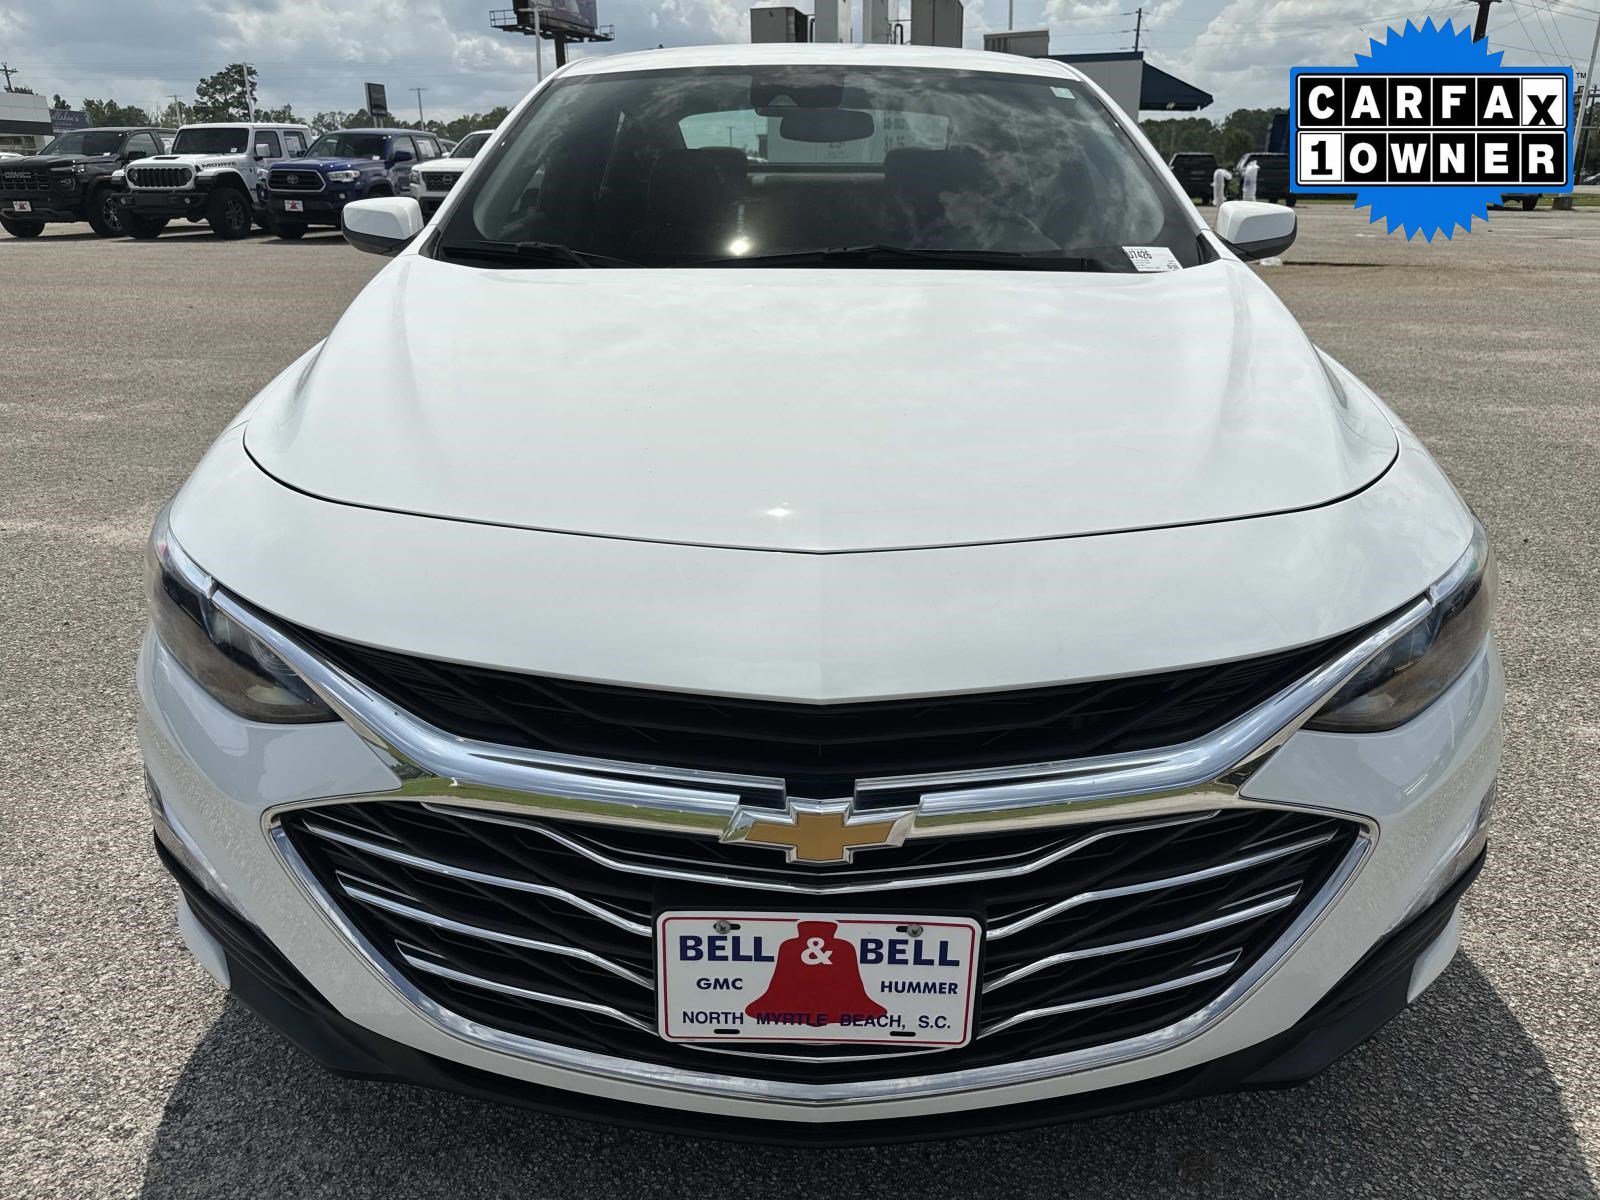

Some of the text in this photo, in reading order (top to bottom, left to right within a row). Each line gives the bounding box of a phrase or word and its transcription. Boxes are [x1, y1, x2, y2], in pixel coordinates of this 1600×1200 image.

[679, 935, 960, 967] BELL & BELL
[696, 977, 743, 991] GMC
[880, 980, 958, 995] HUMMER
[682, 1011, 951, 1030] NORTH MYRTLE BEACH, S.C.
